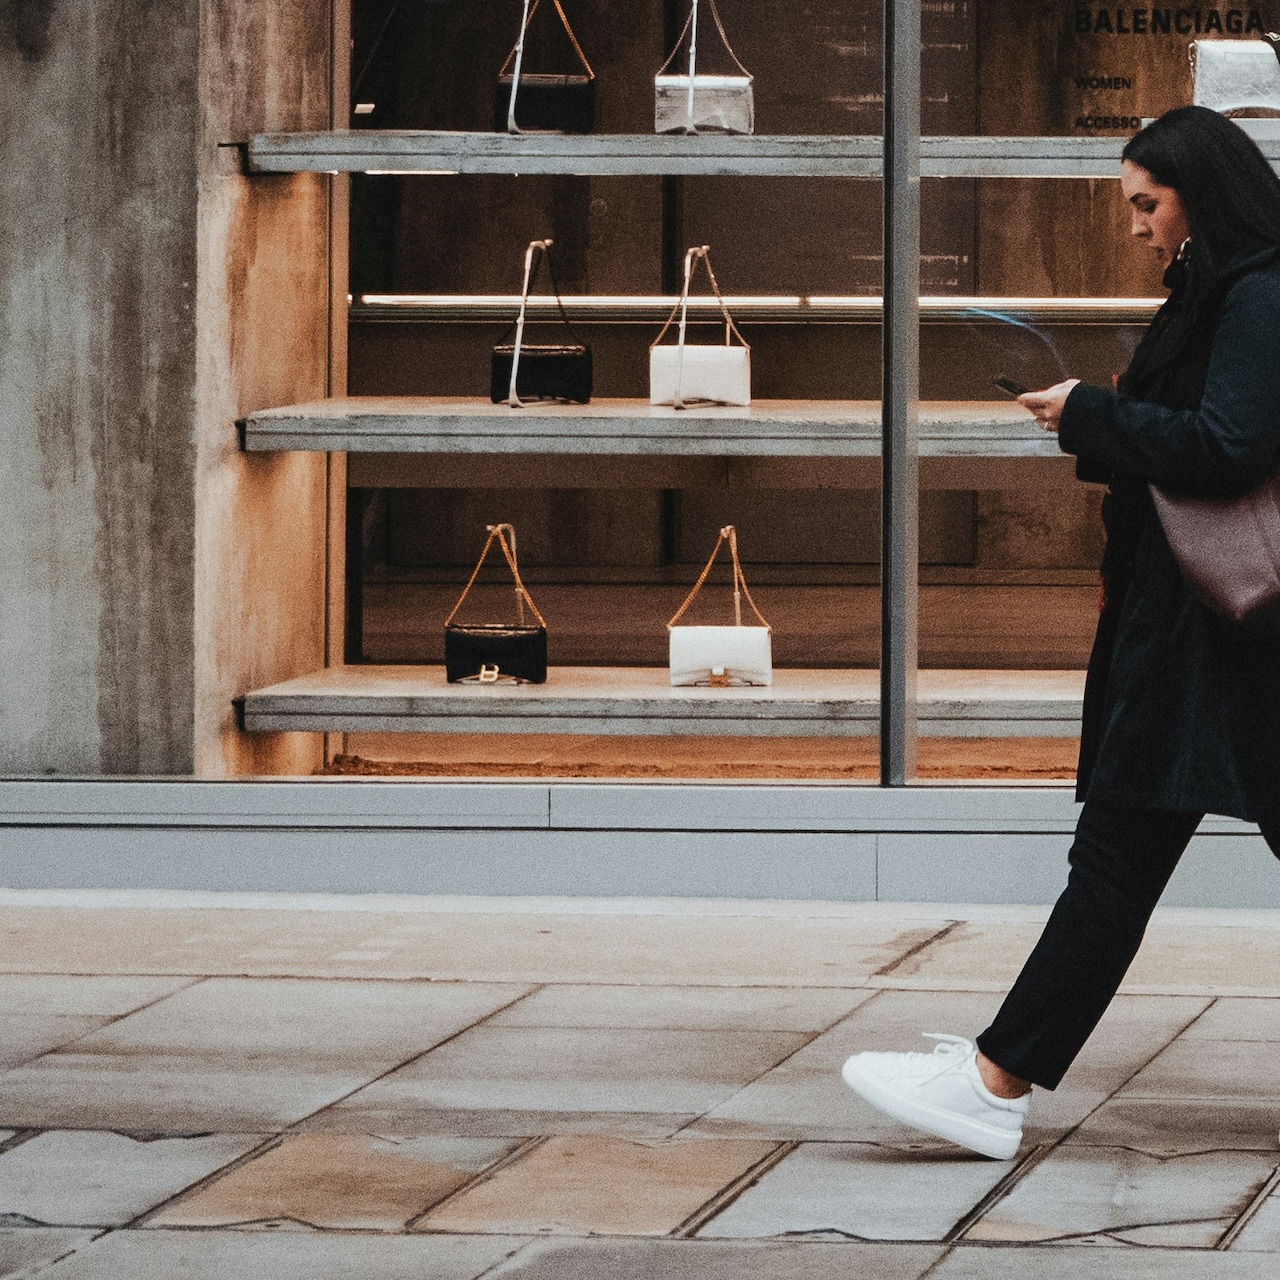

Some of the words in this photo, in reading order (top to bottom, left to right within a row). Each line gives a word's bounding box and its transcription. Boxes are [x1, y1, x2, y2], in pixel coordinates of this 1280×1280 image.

[1075, 8, 1265, 35] BALENCIAGA
[1075, 77, 1132, 90] WOMEN
[1076, 115, 1141, 130] ACCESSO
